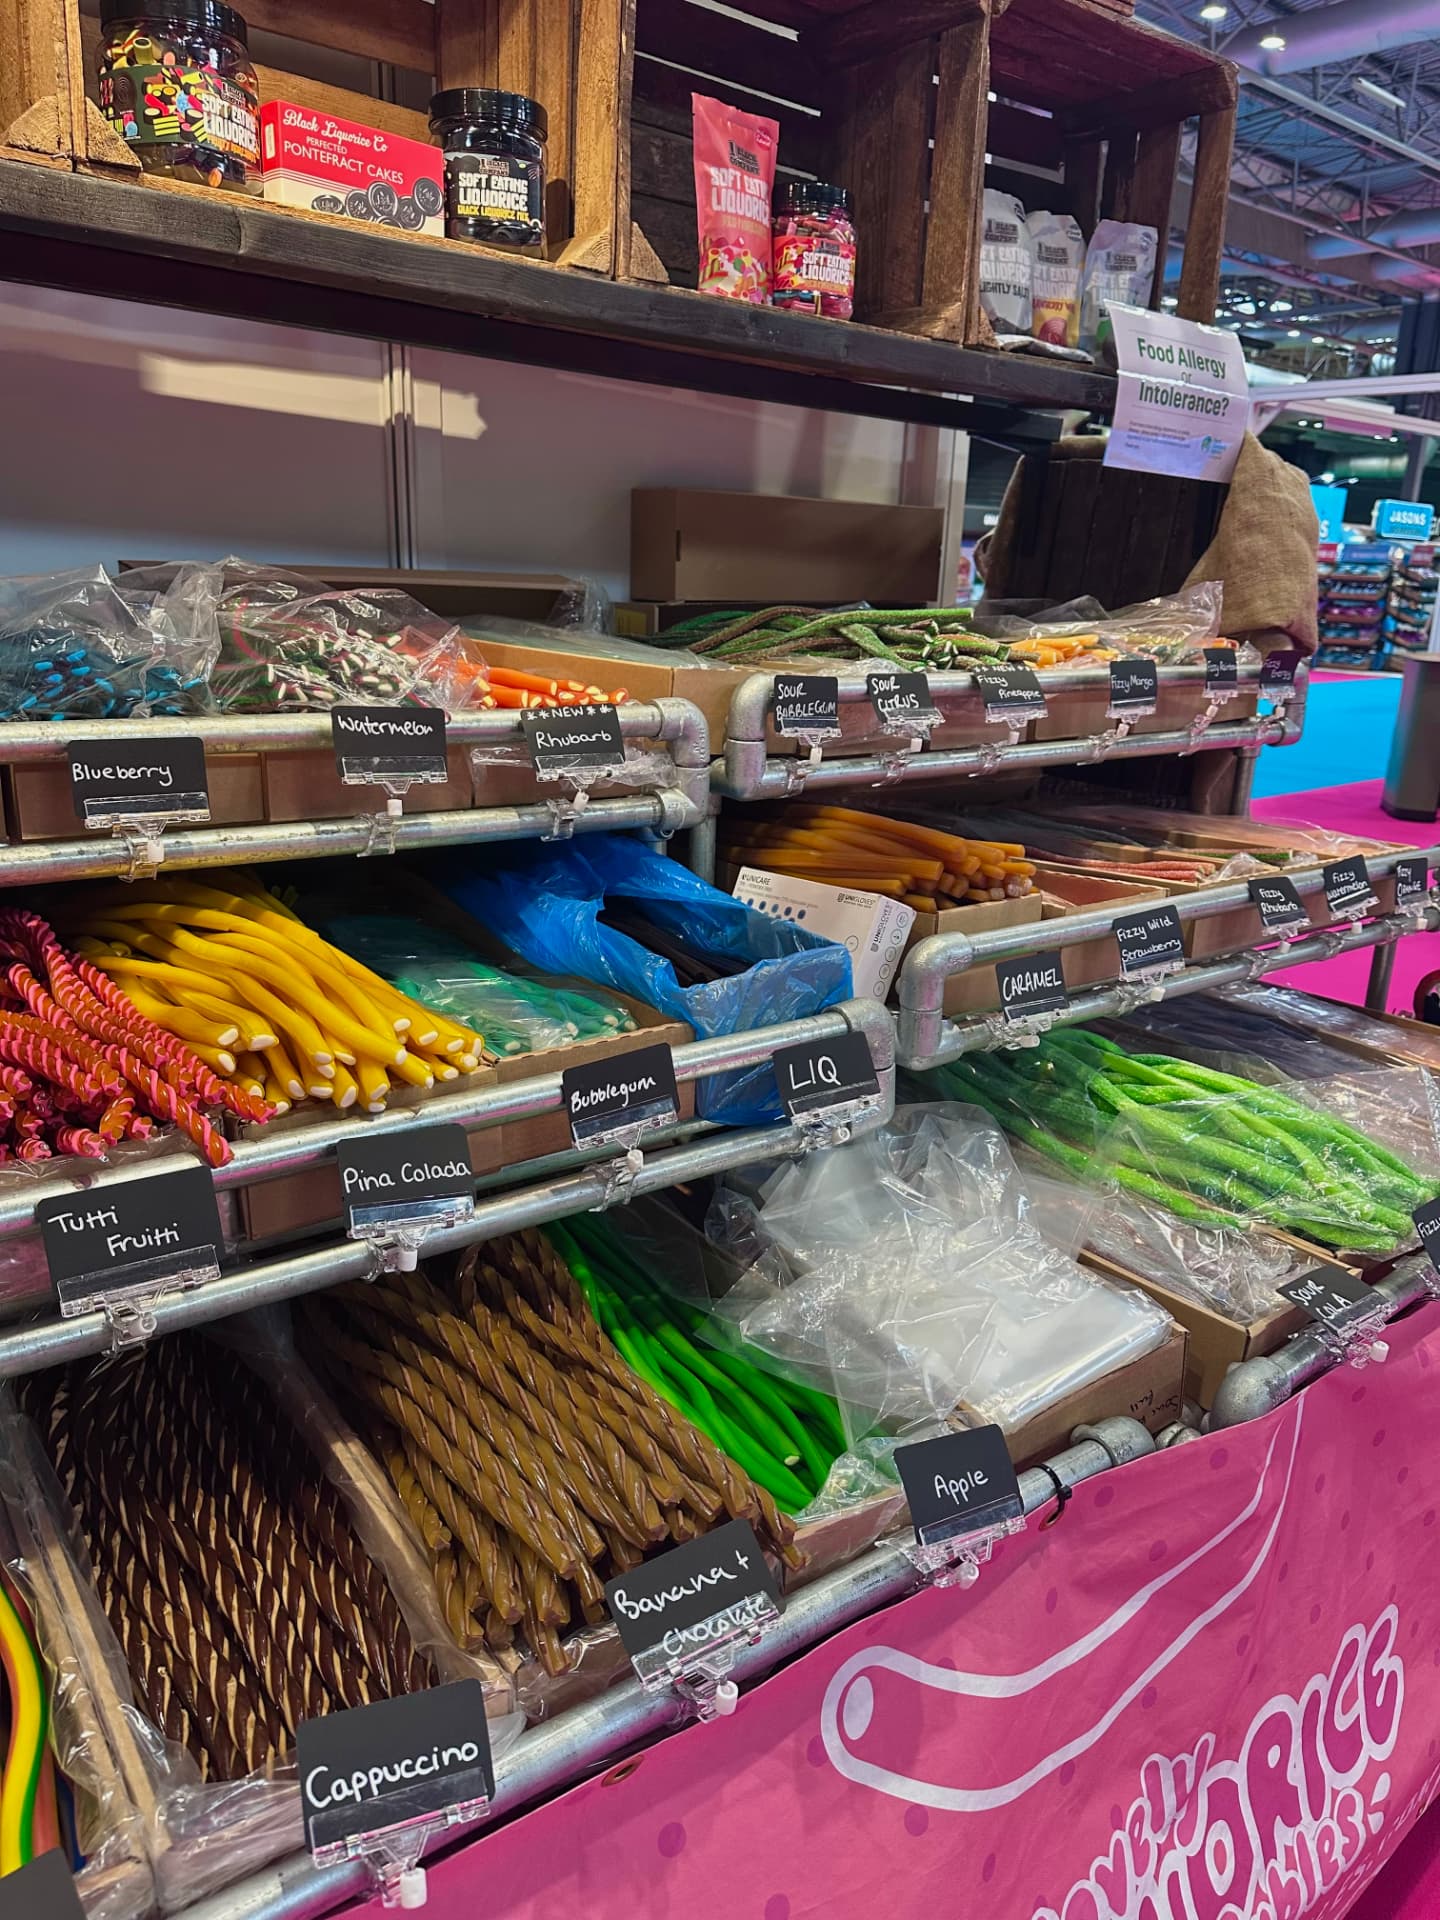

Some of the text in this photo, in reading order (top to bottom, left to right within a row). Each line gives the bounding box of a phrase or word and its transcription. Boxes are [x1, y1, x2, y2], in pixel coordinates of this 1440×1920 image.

[202, 93, 229, 118] SOFT
[283, 109, 388, 153] Black Liquorice Co
[306, 136, 347, 155] PERFECTED
[284, 141, 364, 173] PONTEFRACT
[367, 165, 403, 185] CAKES
[458, 172, 528, 195] SOFT EATING
[710, 167, 742, 188] SOFT
[459, 188, 528, 211] LIQUORICE
[803, 252, 823, 266] SOFT
[802, 265, 850, 285] LIQUORICE
[1137, 337, 1226, 379] Food Allergy
[1139, 382, 1230, 417] Intolerance?
[1389, 511, 1426, 526] JASONS
[778, 682, 807, 700] SOUR
[871, 676, 901, 695] SOUR
[977, 675, 1008, 687] Fizzy
[1111, 674, 1154, 693] Fizzy Mango
[878, 694, 919, 712] CITRUS
[998, 688, 1041, 700] Pineapple
[337, 715, 433, 737] Watermelon
[536, 731, 612, 749] Rhubarb
[72, 762, 172, 787] Blueberry
[1332, 871, 1356, 884] Fizzy
[1259, 888, 1285, 902] Fizzy
[1261, 902, 1298, 915] Rhubarb
[1117, 916, 1174, 942] Fizzy Wild
[1122, 938, 1182, 961] Strawberry
[1002, 968, 1062, 1001] CARAMEL
[788, 1055, 841, 1090] LIQ
[571, 1075, 657, 1113] Bubblegum
[343, 1161, 472, 1193] Pina Colada
[48, 1205, 118, 1233] Tutti
[106, 1222, 180, 1256] Fruitti
[1288, 1280, 1325, 1306] SOUR
[934, 1470, 989, 1505] Apple
[614, 1566, 738, 1620] Banana
[662, 1594, 771, 1656] Chocolate
[305, 1741, 479, 1808] Cappuccino
